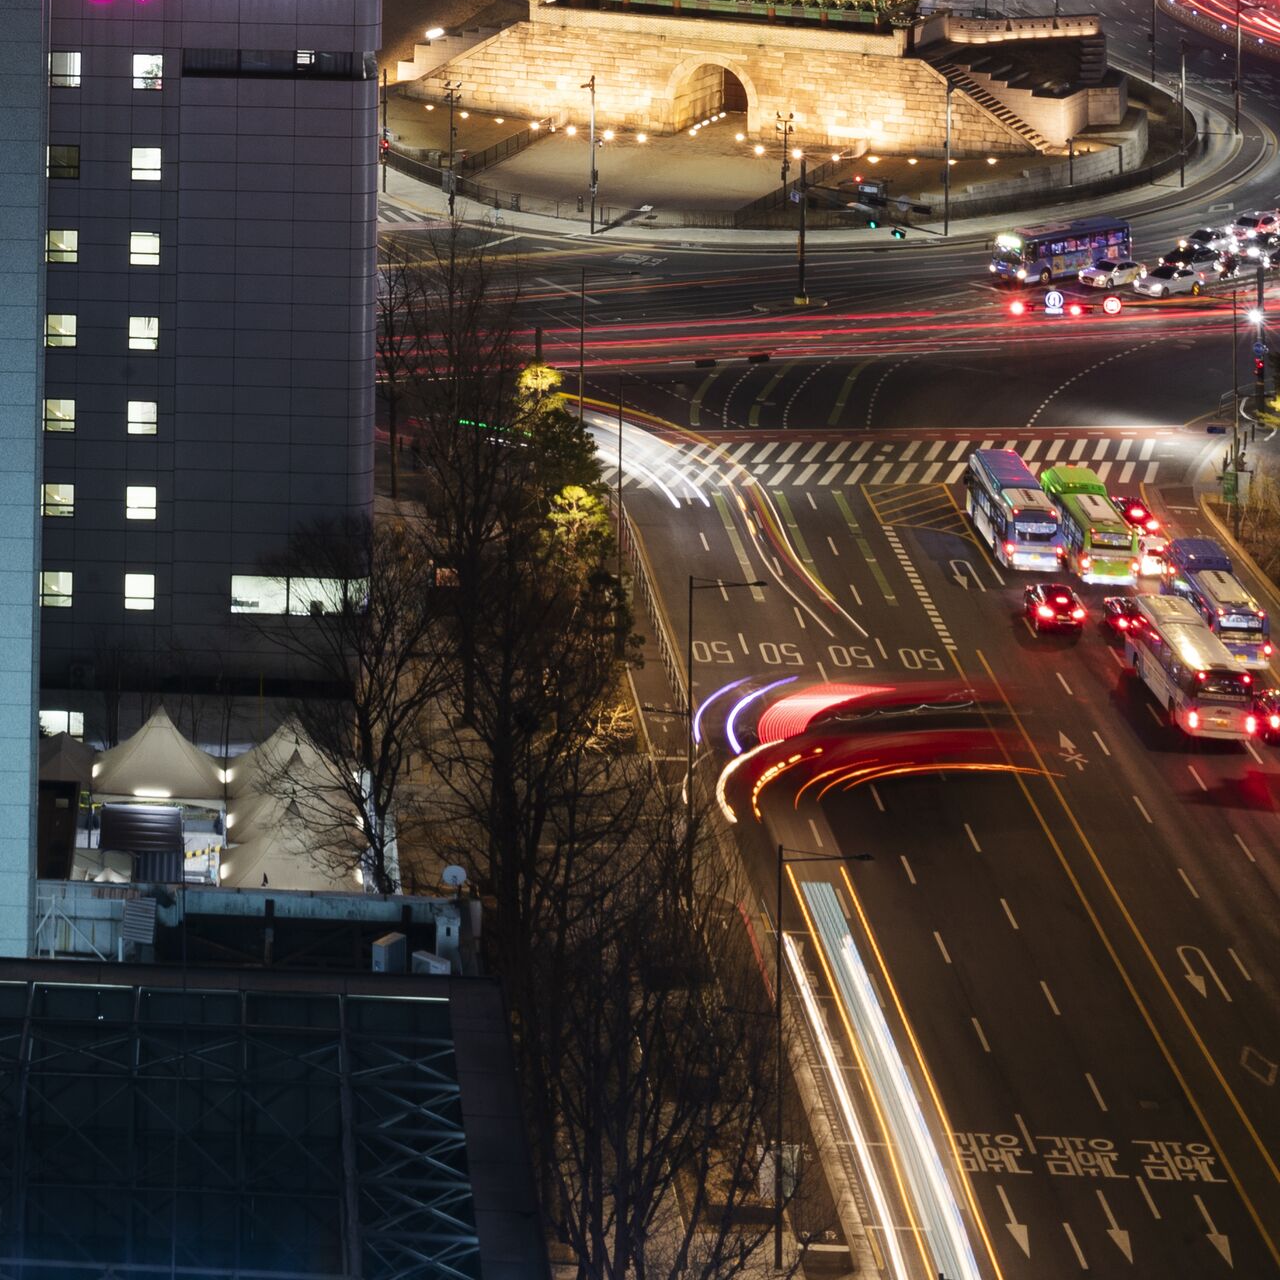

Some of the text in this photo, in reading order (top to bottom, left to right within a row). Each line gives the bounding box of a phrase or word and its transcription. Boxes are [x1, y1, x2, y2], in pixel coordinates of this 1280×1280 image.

[692, 639, 735, 664] 50
[758, 642, 804, 666] 50
[826, 644, 875, 669] 50
[897, 647, 945, 671] 50
